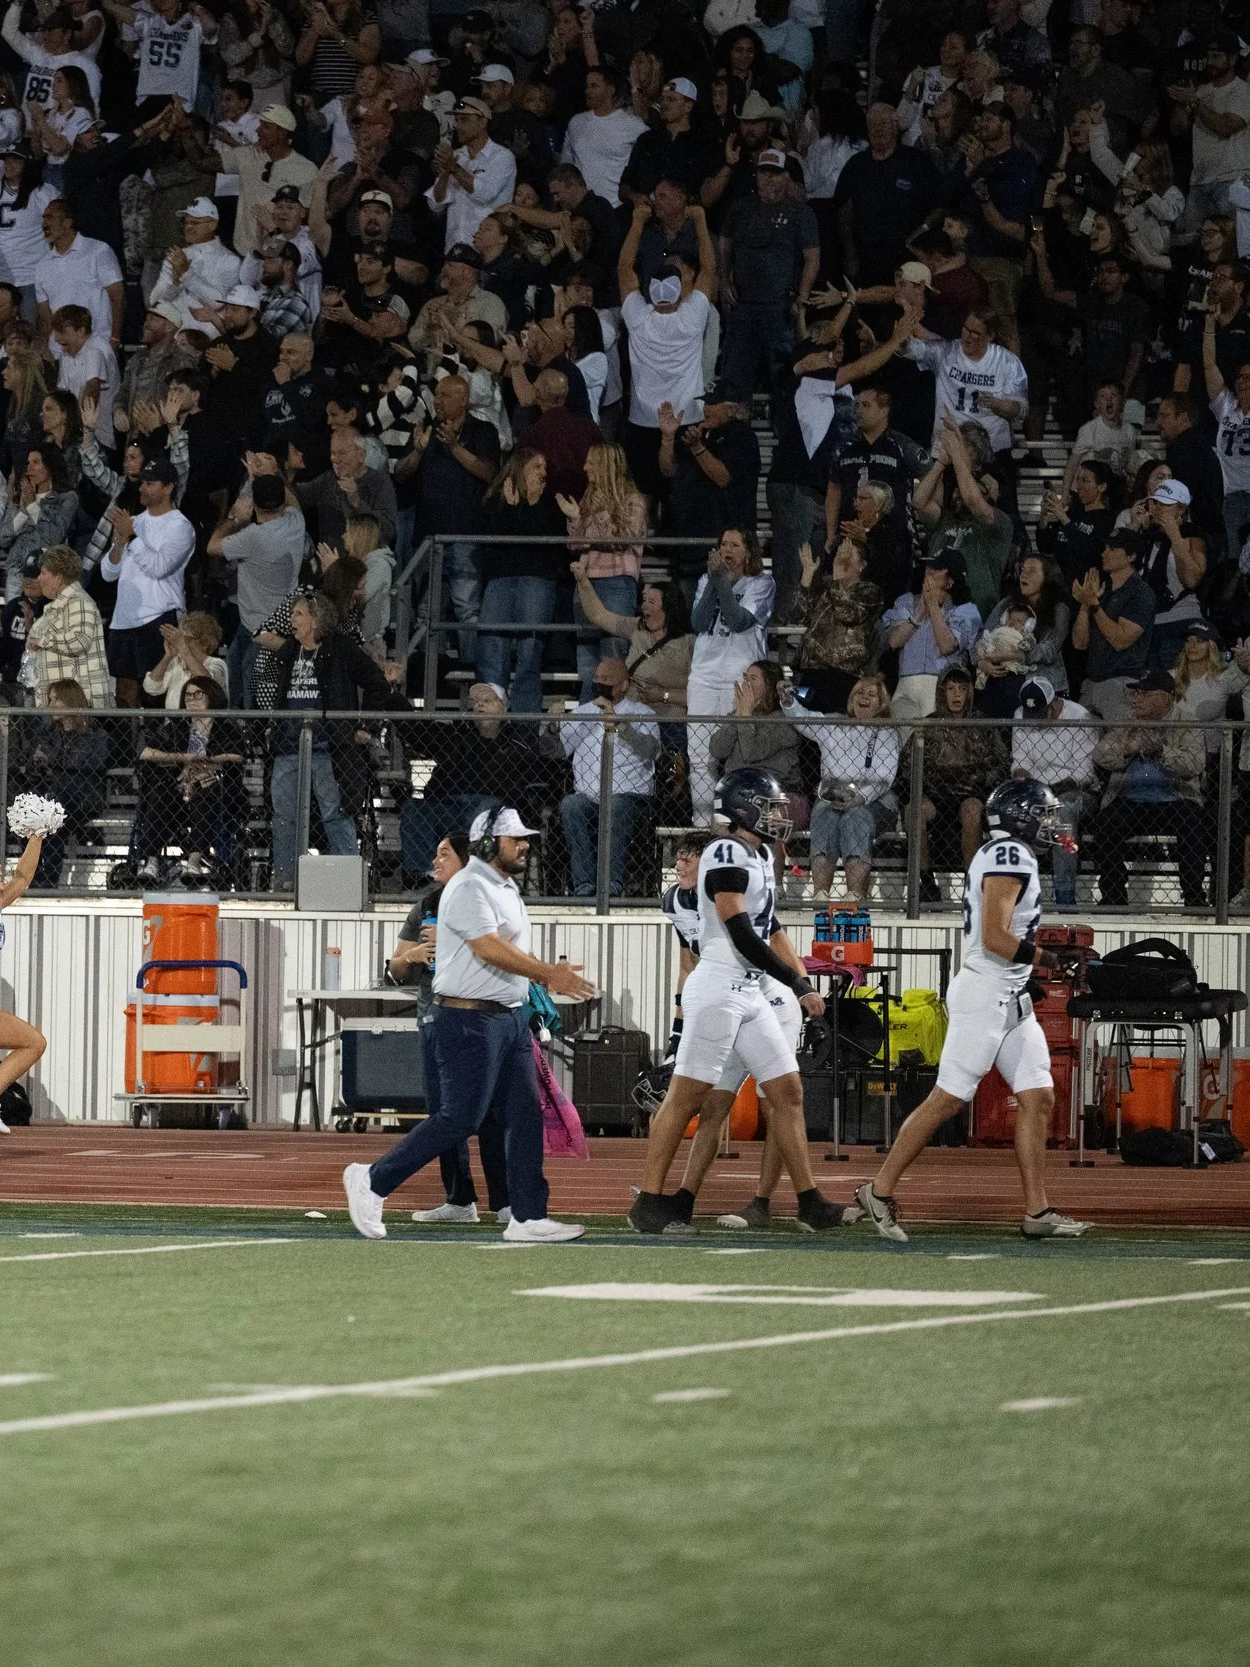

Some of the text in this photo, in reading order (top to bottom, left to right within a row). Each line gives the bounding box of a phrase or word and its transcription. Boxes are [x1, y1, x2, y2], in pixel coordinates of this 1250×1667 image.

[149, 40, 187, 68] 55
[27, 77, 51, 103] 85
[950, 366, 996, 387] CHARGERS
[955, 387, 980, 414] 11
[713, 843, 734, 864] 41
[996, 846, 1020, 865] 26
[831, 945, 845, 962] G
